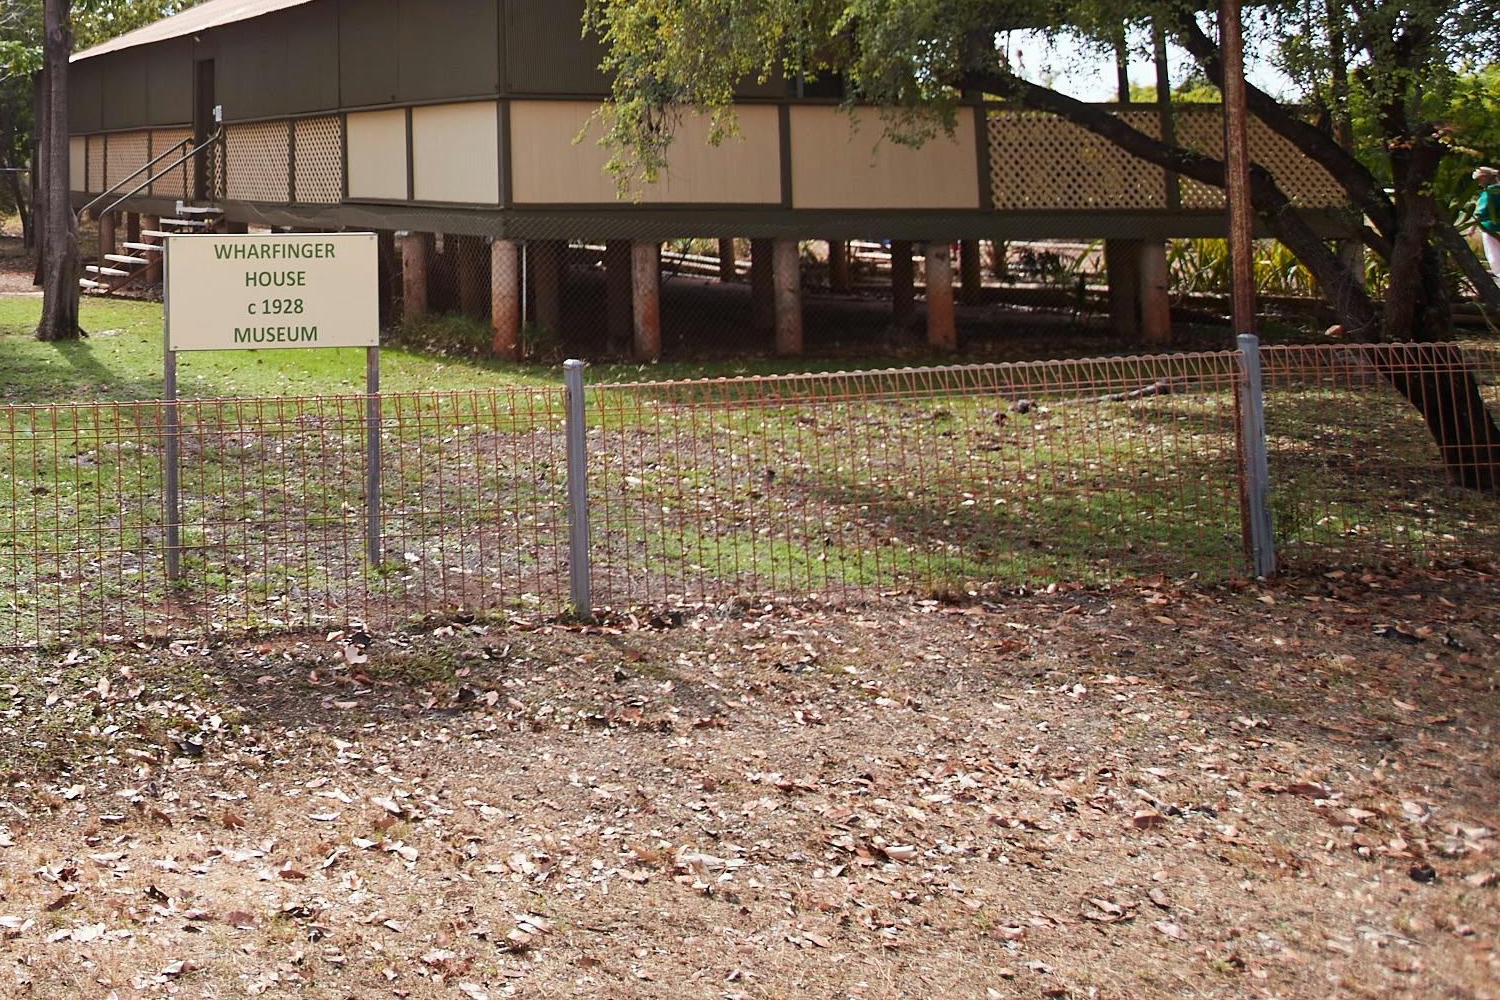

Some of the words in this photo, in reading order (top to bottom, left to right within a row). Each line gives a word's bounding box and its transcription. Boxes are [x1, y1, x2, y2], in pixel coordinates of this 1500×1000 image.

[214, 243, 335, 259] WHARFINGER
[245, 271, 306, 286] HOUSE
[247, 302, 256, 314] c
[262, 299, 304, 314] 1928
[234, 326, 318, 342] MUSEUM
